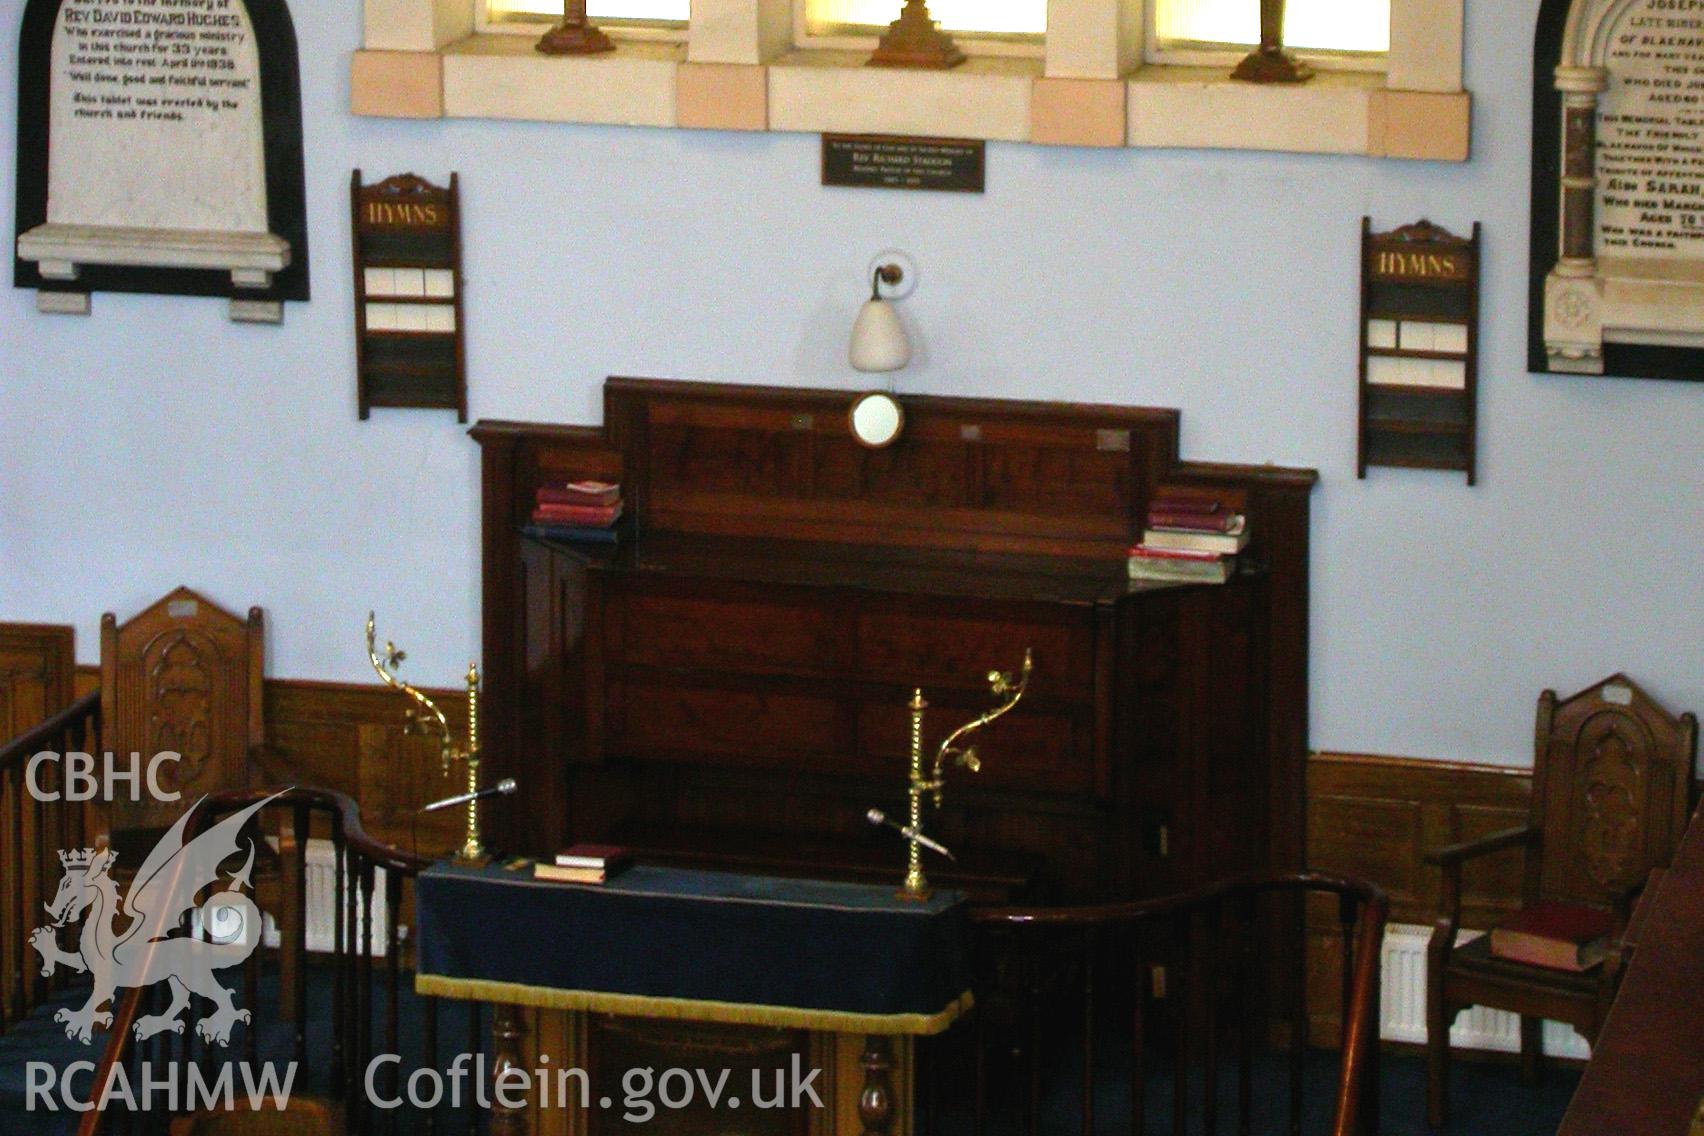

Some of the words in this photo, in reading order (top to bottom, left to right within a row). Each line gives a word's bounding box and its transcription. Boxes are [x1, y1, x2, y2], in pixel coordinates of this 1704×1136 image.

[65, 8, 90, 23] REV
[92, 8, 132, 23] DAVID
[133, 10, 185, 25] EDWARD
[187, 11, 239, 27] HUGHES
[369, 202, 437, 225] HYMNS
[1379, 251, 1456, 276] HYMNS
